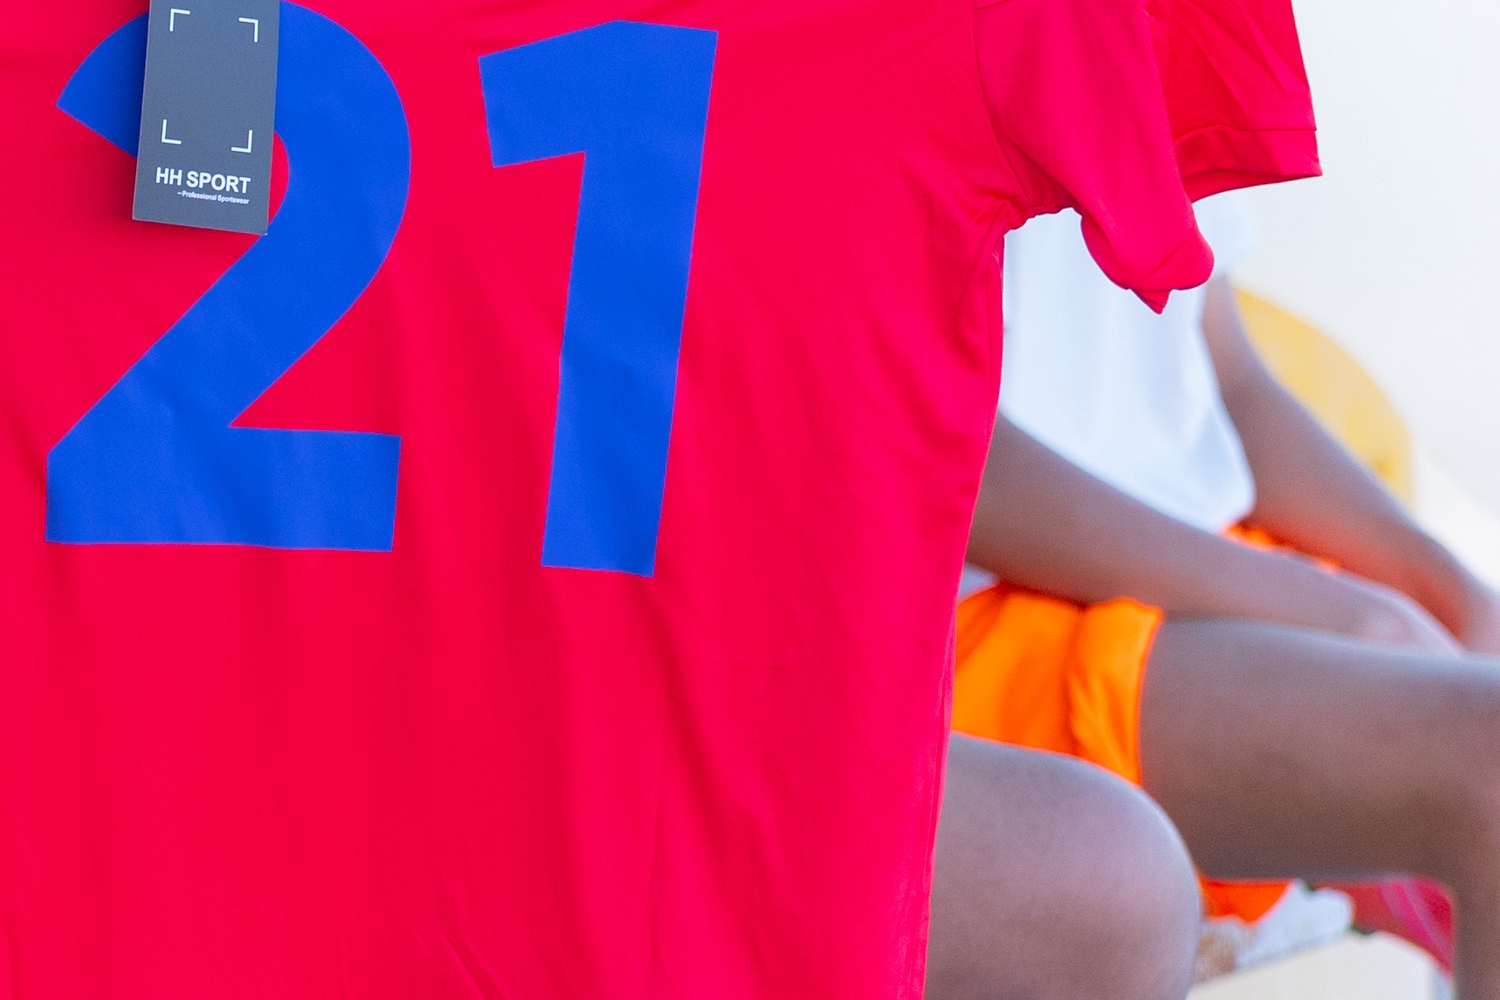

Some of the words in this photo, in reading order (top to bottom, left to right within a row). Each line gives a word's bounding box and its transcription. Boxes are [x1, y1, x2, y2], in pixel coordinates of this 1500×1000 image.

[155, 167, 183, 186] HH
[186, 170, 251, 193] SPORT
[217, 194, 249, 204] Sportswear
[45, 0, 719, 577] 21
